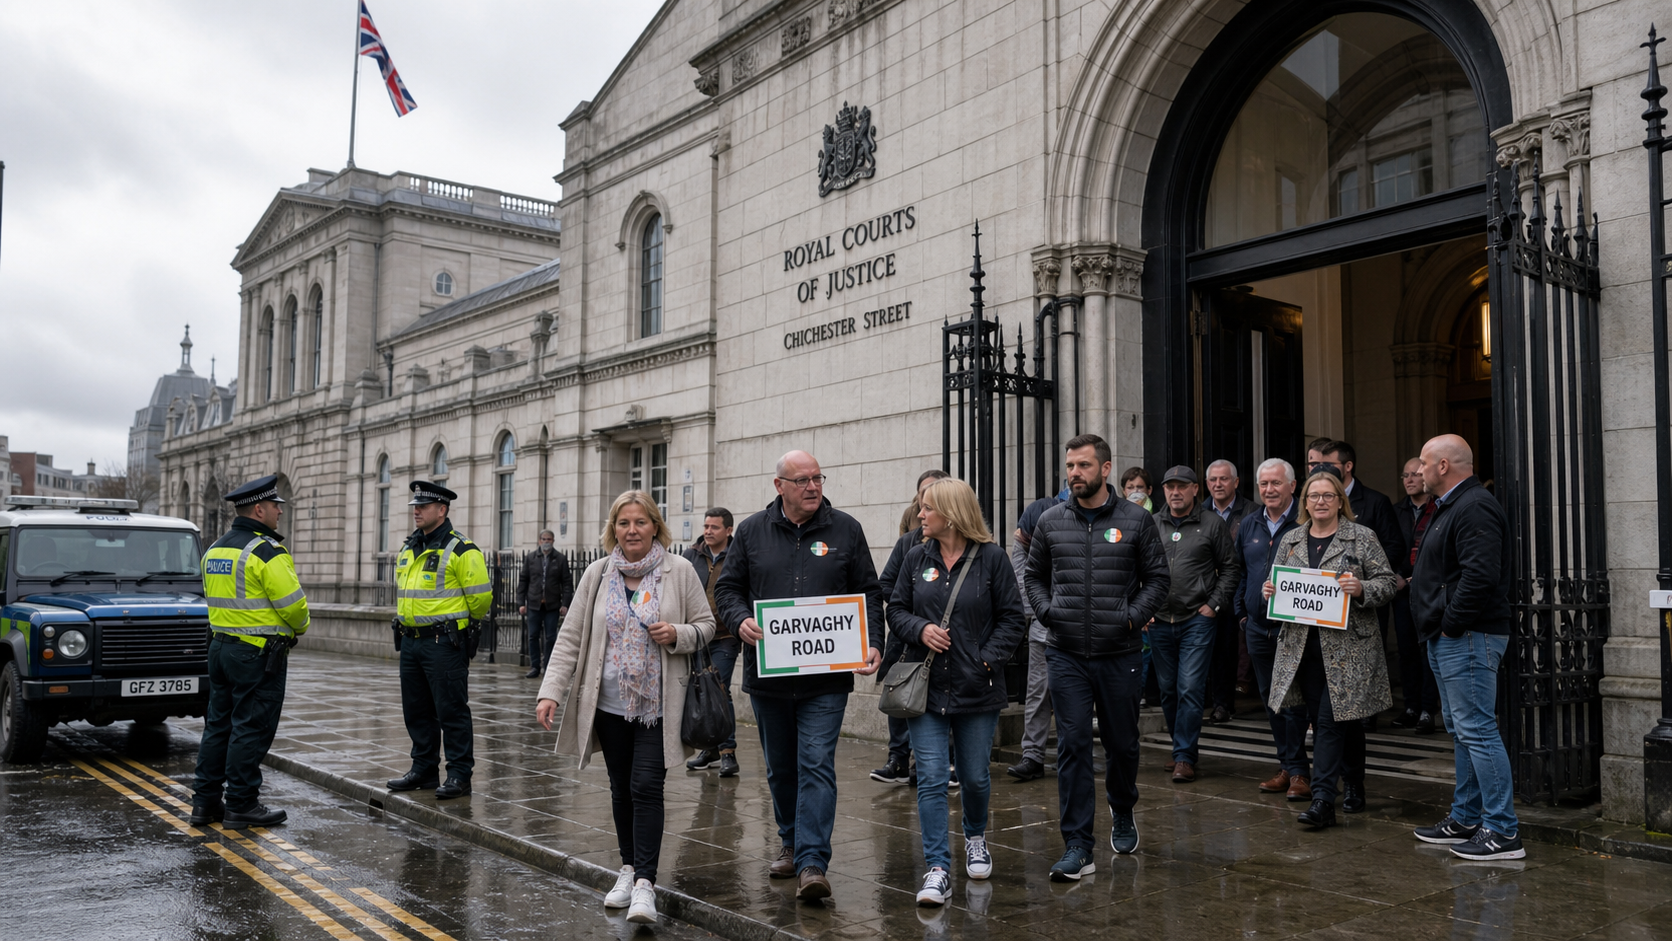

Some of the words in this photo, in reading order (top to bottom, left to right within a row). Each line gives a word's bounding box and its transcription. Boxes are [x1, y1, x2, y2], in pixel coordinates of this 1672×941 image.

[783, 235, 836, 272] ROYAL
[841, 205, 916, 251] COURTS
[797, 278, 819, 304] OF
[825, 253, 897, 300] JUSTICE
[783, 317, 856, 351] CHICHESTER
[863, 301, 912, 330] STREET
[1280, 580, 1341, 598] GARVAGHY
[1292, 597, 1323, 612] ROAD
[769, 615, 854, 635] GARVAGHY
[791, 638, 835, 656] ROAD
[129, 681, 155, 694] GFZ
[159, 679, 192, 692] 3785
